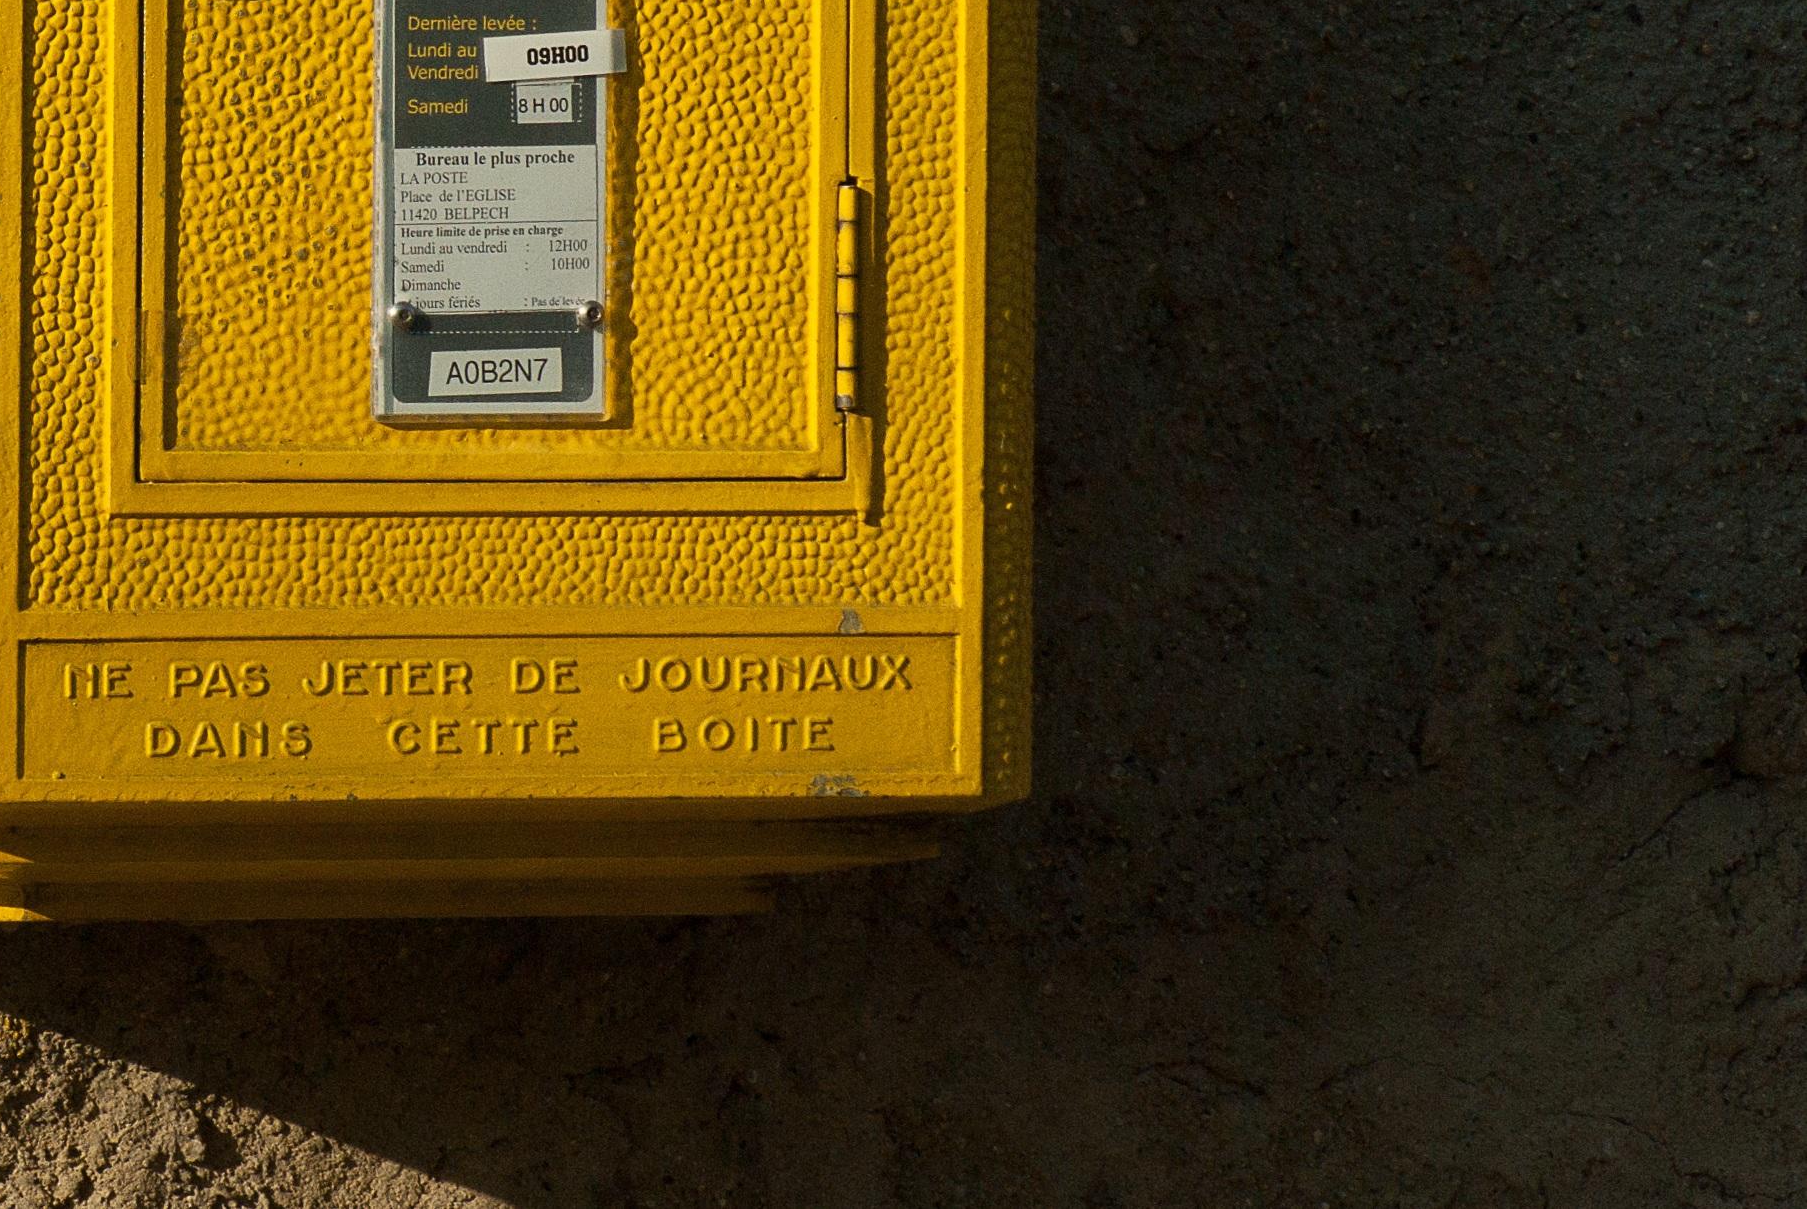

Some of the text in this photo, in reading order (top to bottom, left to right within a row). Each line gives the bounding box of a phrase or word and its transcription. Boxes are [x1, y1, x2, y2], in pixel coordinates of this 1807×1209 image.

[408, 15, 477, 30] Dernière
[483, 15, 525, 30] levée
[408, 43, 477, 58] Lundi au
[527, 44, 589, 65] 09H00
[408, 65, 478, 79] Vendredi
[408, 99, 468, 114] Samedi
[416, 150, 575, 168] Bureau le plus proche
[400, 171, 468, 185] LA POSTE
[400, 189, 516, 203] Place de l'EGLISE
[401, 207, 509, 221] 11420 BELPECH
[401, 225, 563, 238] Heure limite de prise en charge
[401, 243, 436, 255] Lundi
[439, 244, 453, 254] au
[457, 241, 507, 253] vendredi
[549, 240, 588, 252] 12H00
[401, 260, 444, 273] Samedi
[551, 257, 590, 270] 10H00
[401, 278, 461, 291] Dimanche
[415, 297, 445, 309] jours
[449, 296, 481, 308] fériés
[532, 297, 547, 307] Pas
[549, 296, 560, 306] de
[446, 358, 548, 384] A0B2N7
[63, 654, 913, 699] NE PAS JETER DE JOURNAUX
[145, 714, 836, 758] DANS CETTE BOITE
